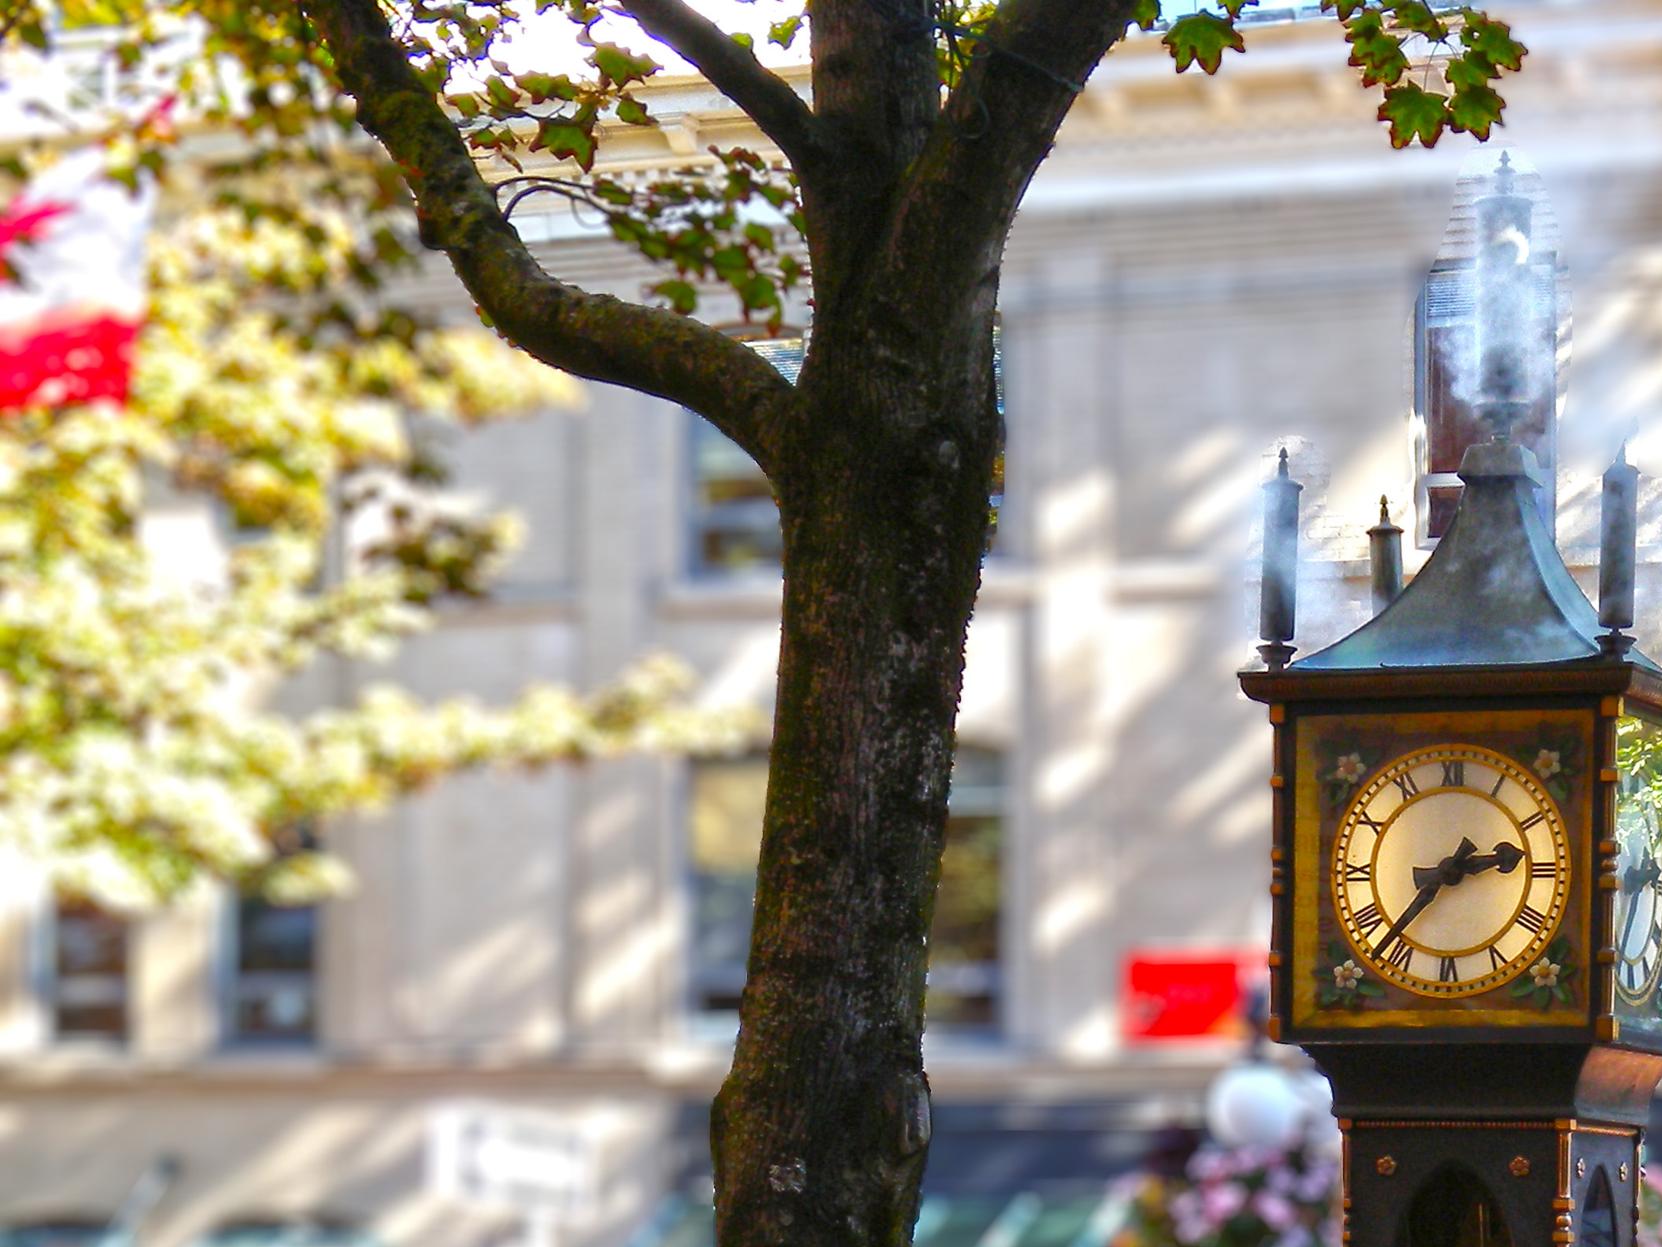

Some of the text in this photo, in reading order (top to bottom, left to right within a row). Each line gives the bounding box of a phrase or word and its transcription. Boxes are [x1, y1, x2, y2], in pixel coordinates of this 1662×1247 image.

[1391, 772, 1421, 802] XI
[1440, 760, 1464, 788] XII
[1490, 773, 1506, 798] I
[1356, 810, 1385, 836] X
[1519, 811, 1545, 833] II
[1345, 863, 1371, 882] IX
[1531, 862, 1556, 878] III
[1352, 902, 1384, 938] VIII
[1515, 904, 1546, 934] IIII
[1439, 957, 1459, 982] VI
[1488, 944, 1508, 970] V
